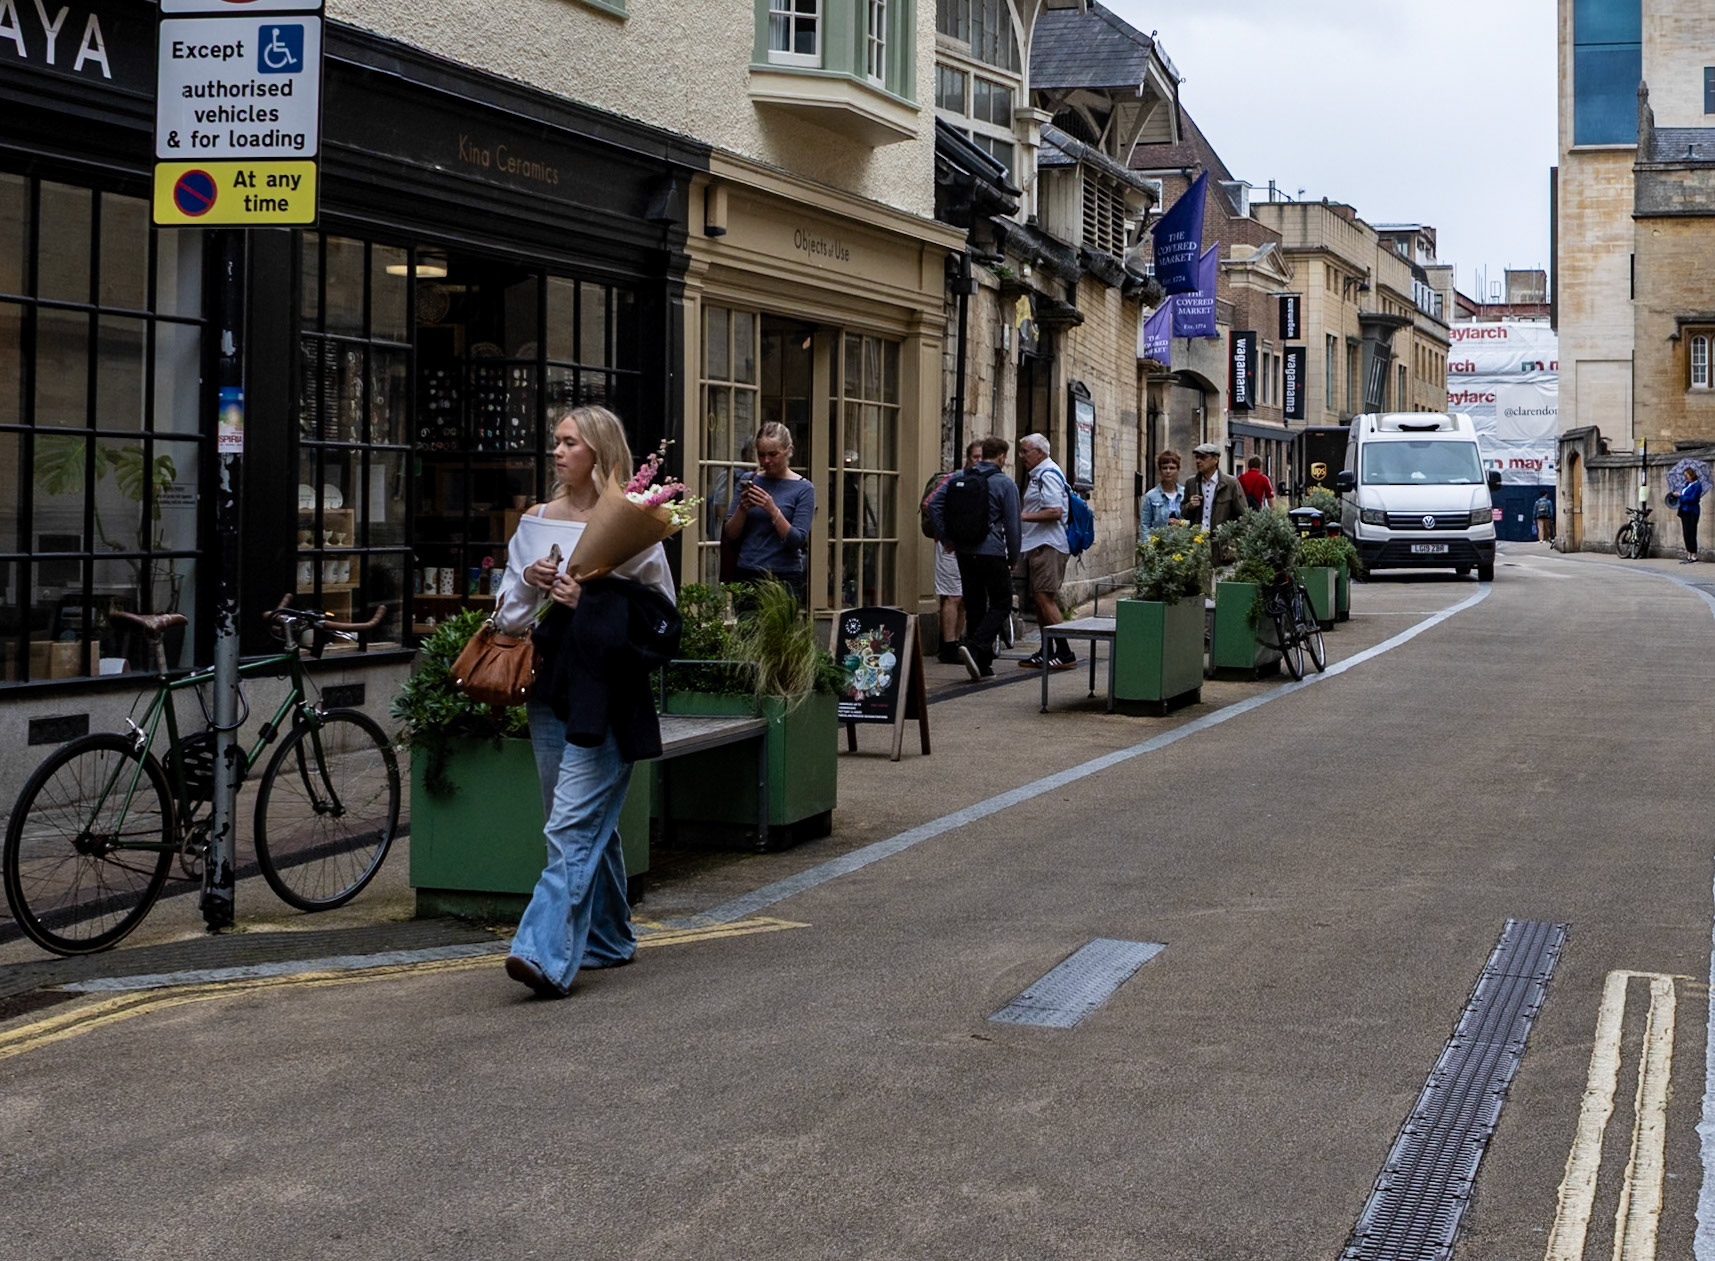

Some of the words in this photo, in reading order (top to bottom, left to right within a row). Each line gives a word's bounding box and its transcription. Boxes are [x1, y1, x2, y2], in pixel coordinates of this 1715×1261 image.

[172, 40, 244, 61] Except
[182, 79, 293, 98] authorised
[194, 105, 279, 123] vehicles
[167, 132, 181, 148] &
[191, 130, 220, 148] for
[229, 129, 305, 150] loading
[459, 134, 489, 167] Kina
[496, 145, 559, 184] Ceramics
[233, 170, 256, 188] At
[266, 172, 302, 191] any
[243, 195, 289, 212] time
[794, 228, 827, 258] Objects
[834, 240, 849, 262] Use
[1168, 231, 1185, 242] THE
[1157, 241, 1197, 256] COVERED
[1159, 252, 1194, 266] MARKET
[1176, 298, 1214, 306] COVERED
[1178, 307, 1211, 315] MARKET
[1234, 338, 1246, 403] wagamama
[1285, 353, 1296, 413] wagamama
[1509, 456, 1549, 471] may
